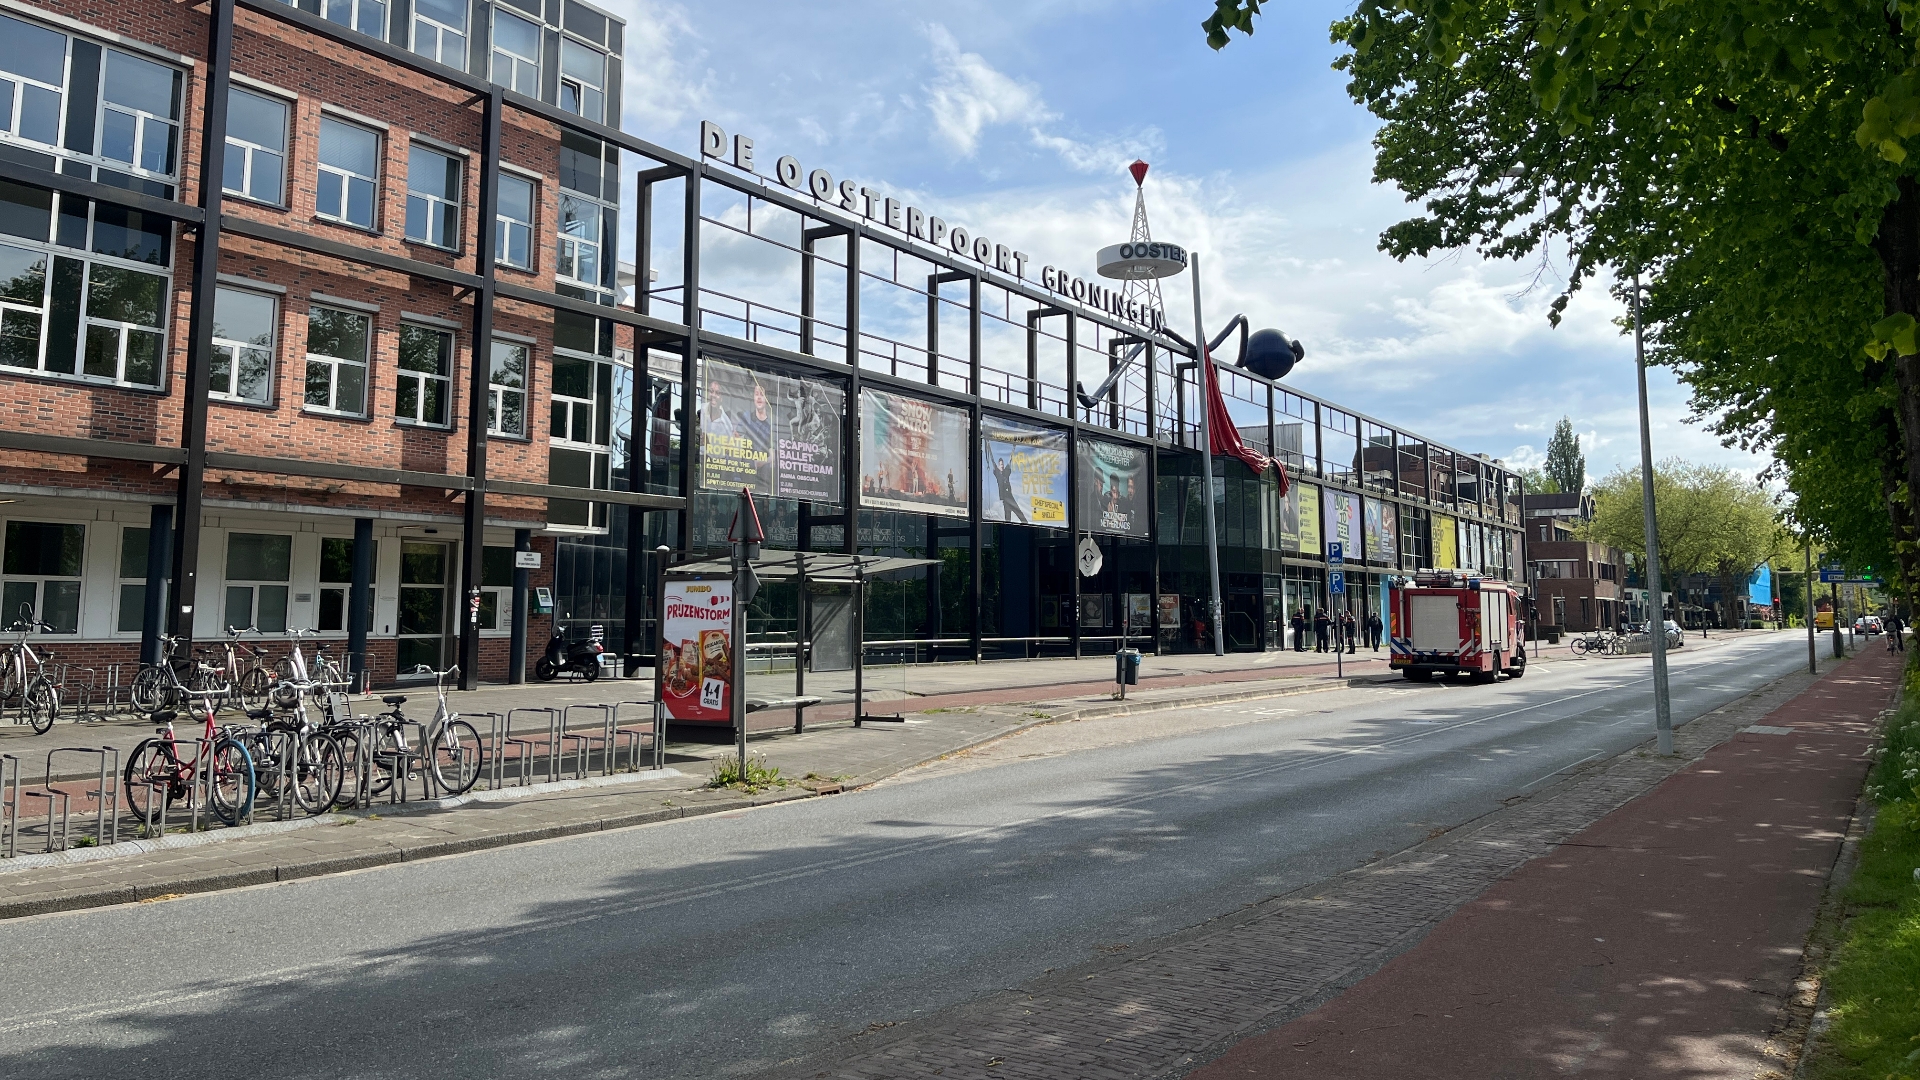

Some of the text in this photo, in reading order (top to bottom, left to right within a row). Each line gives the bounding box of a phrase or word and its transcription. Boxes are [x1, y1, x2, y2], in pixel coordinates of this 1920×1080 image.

[701, 120, 1166, 332] DE OOSTERPOORT GRONINGEN
[1120, 243, 1187, 264] OOSTER
[901, 403, 933, 421] SNOW
[897, 415, 935, 435] PATROL
[707, 433, 753, 450] THEATER
[779, 438, 819, 453] SCAPINO
[706, 443, 768, 462] ROTTERDAM
[780, 449, 813, 463] BALLET
[706, 463, 736, 473] EXISTENCE
[780, 460, 833, 475] ROTTERDAM
[1339, 512, 1347, 523] TO
[1331, 543, 1340, 555] P
[1332, 573, 1341, 585] P
[686, 585, 712, 593] JUMBO
[666, 603, 731, 620] PRIJZENSTORM
[704, 681, 721, 700] 1+1
